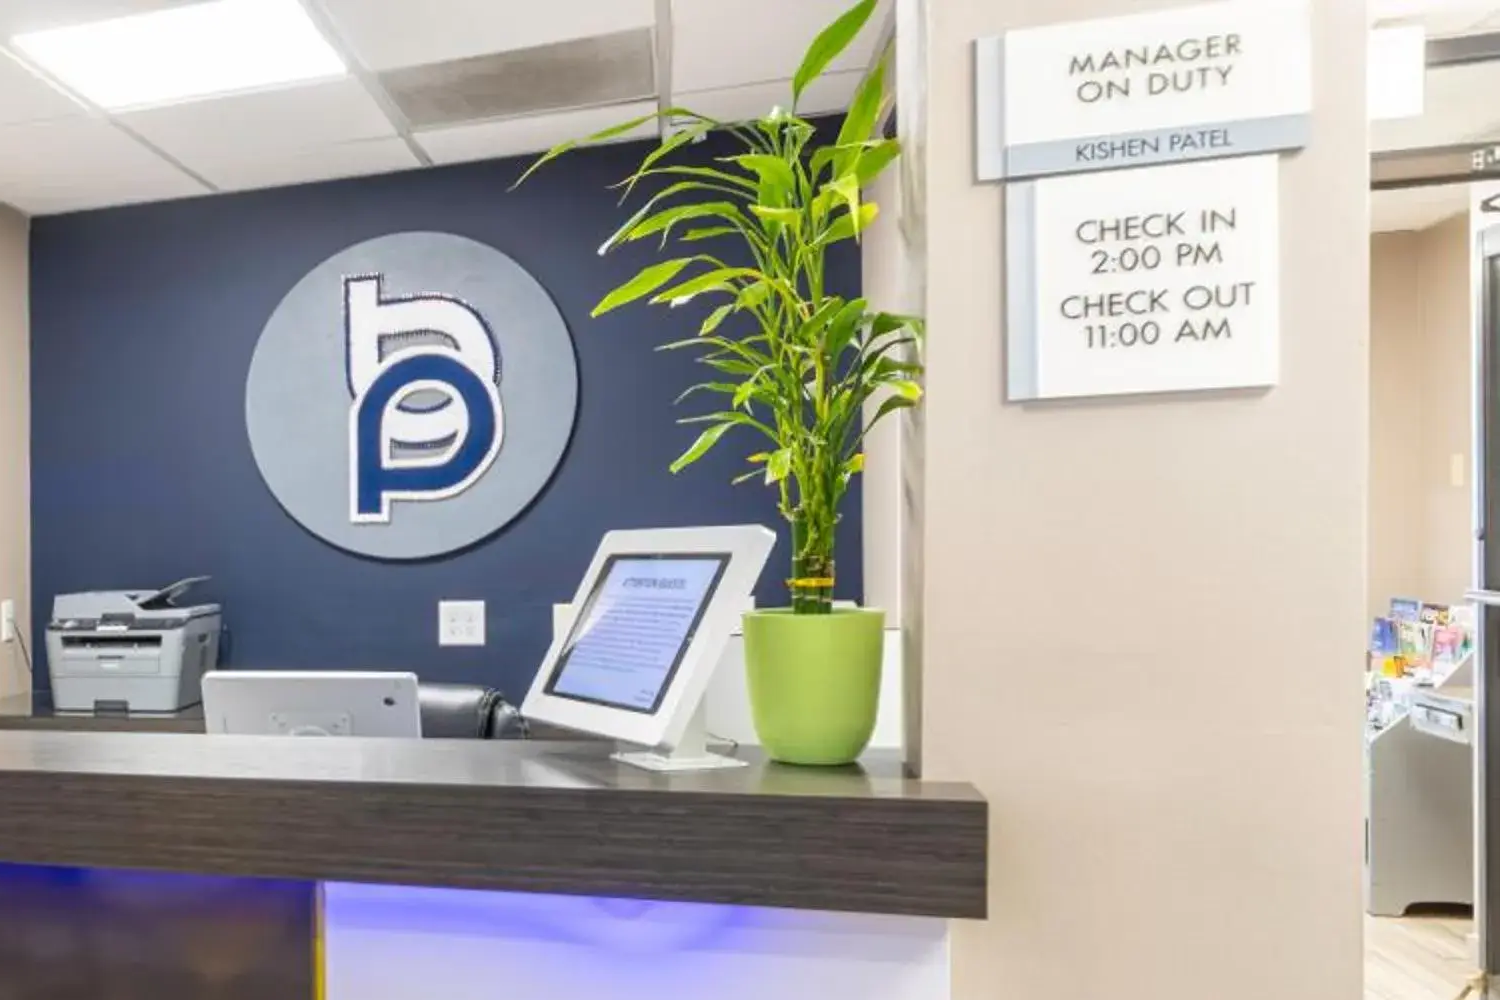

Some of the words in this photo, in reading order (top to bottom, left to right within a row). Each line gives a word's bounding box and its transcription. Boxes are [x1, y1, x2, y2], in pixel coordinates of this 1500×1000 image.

[1068, 33, 1242, 76] MANAGER
[1076, 77, 1131, 103] ON
[1148, 65, 1233, 96] DUTY
[1075, 135, 1160, 163] KISHEN
[1169, 128, 1233, 152] PATEL
[1075, 210, 1187, 245] CHECK
[1200, 207, 1236, 234] IN
[1090, 245, 1162, 275] 2:00
[1175, 241, 1223, 267] PM
[1059, 289, 1171, 321] CHECK
[1183, 281, 1257, 311] OUT
[1084, 320, 1161, 350] 11:00
[1173, 317, 1233, 343] AM
